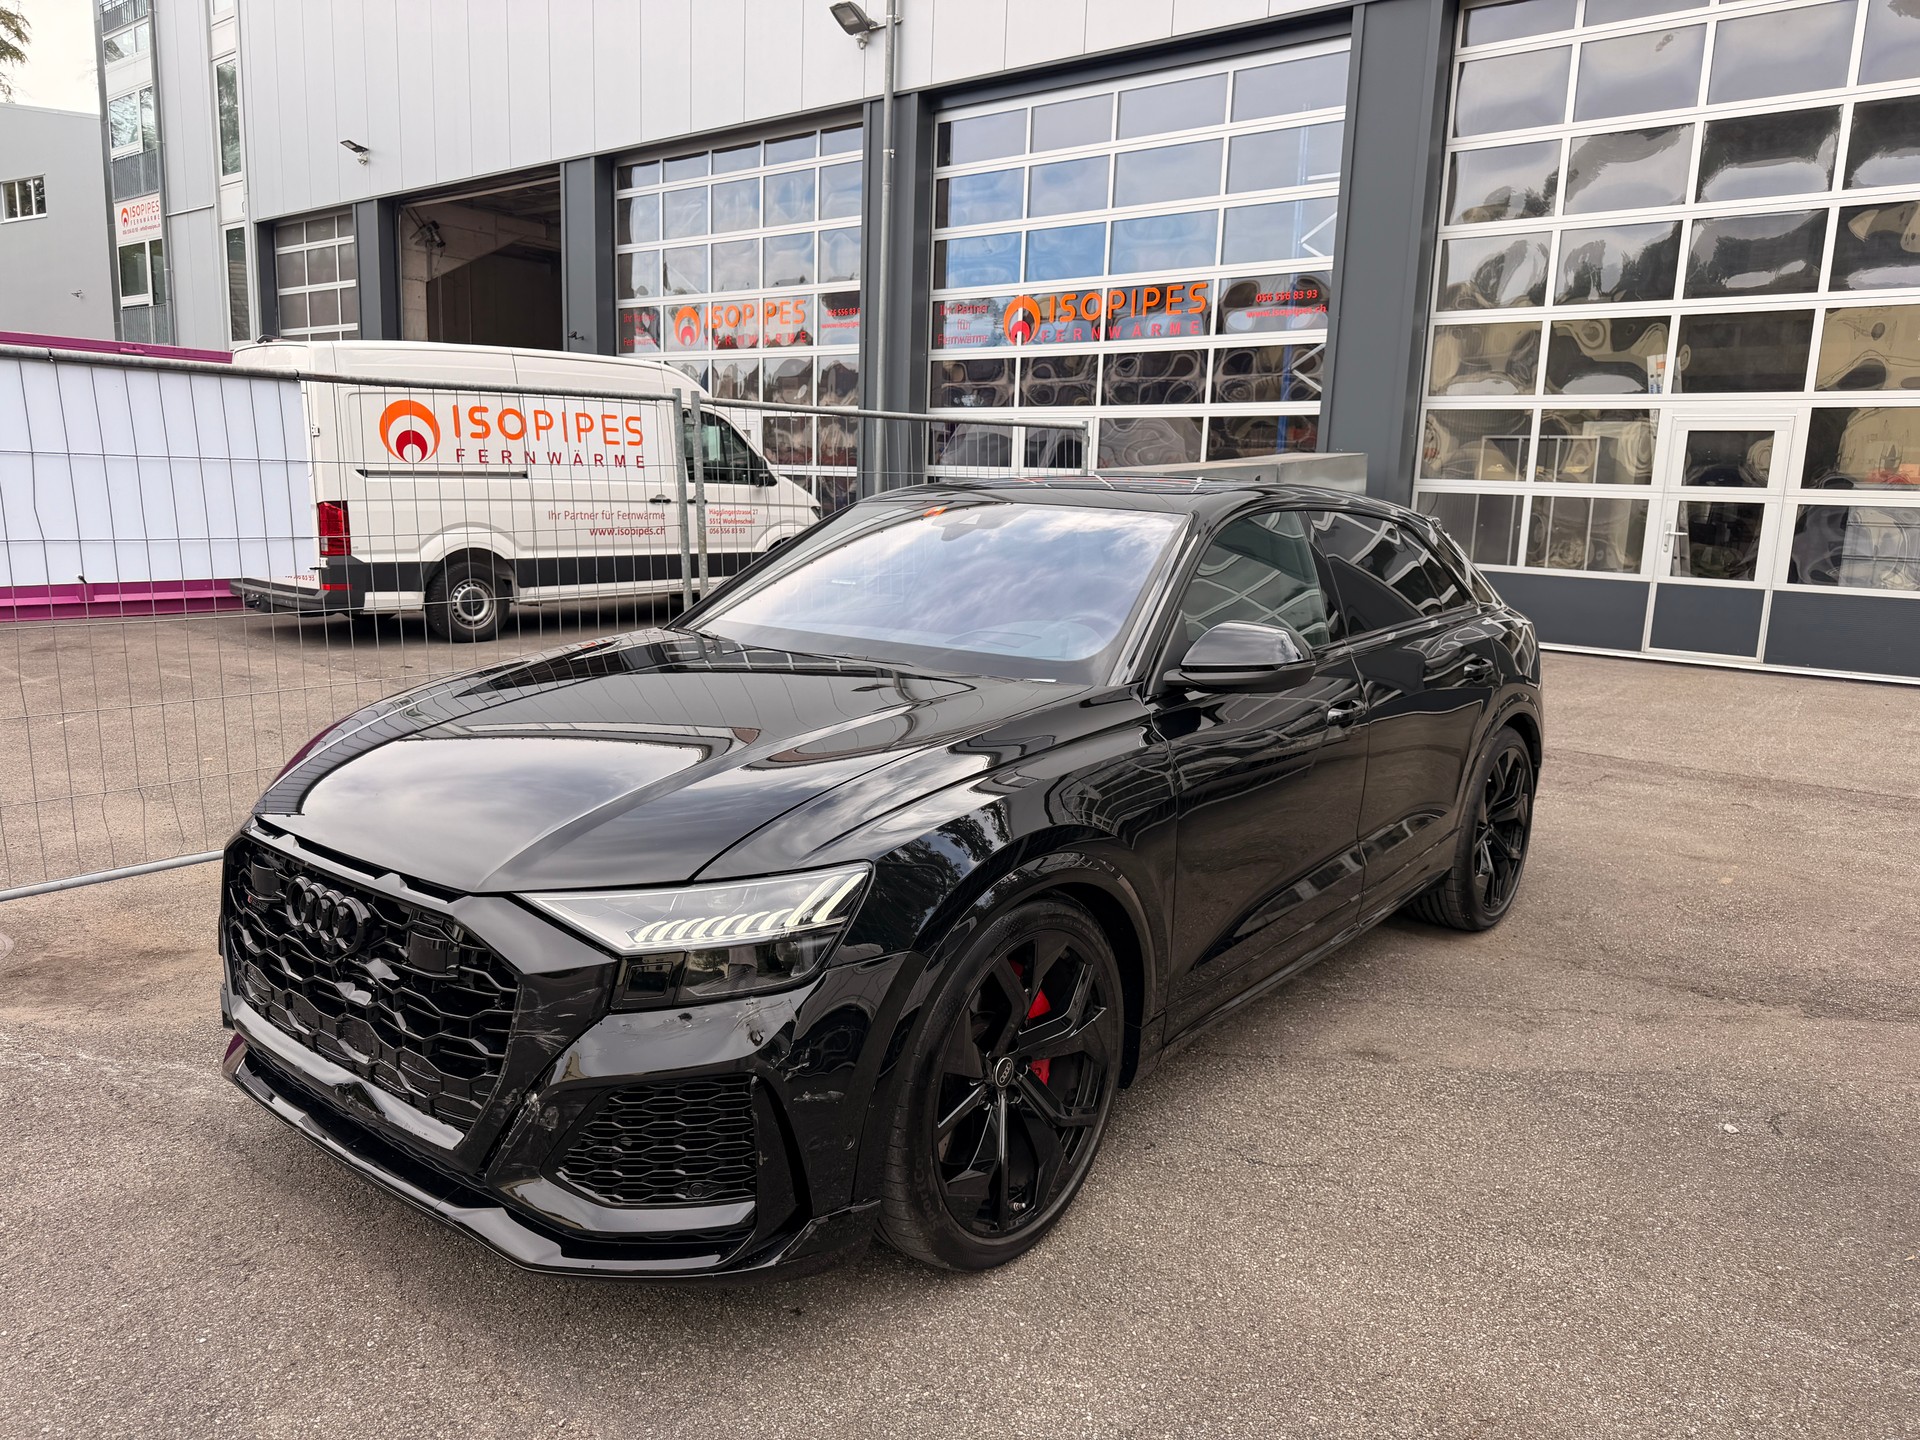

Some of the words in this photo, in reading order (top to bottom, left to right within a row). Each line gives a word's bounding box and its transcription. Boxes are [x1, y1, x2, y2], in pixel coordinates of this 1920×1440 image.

[130, 200, 160, 218] ISOPIPES
[1049, 281, 1208, 323] ISOPIPES
[1255, 292, 1273, 303] 056
[1275, 291, 1291, 302] 556
[1293, 290, 1305, 300] 83
[1306, 288, 1319, 299] 93
[704, 299, 806, 329] ISOPIPES
[1246, 304, 1327, 318] www.isopipes.ch
[1041, 320, 1200, 343] FERNWÄRME
[452, 404, 644, 447] ISOPIPES
[456, 448, 646, 470] FERNWÄRME
[548, 510, 561, 520] Ihr
[564, 510, 599, 520] Partner
[601, 509, 614, 520] für
[617, 510, 666, 520] Fernwärme
[589, 525, 666, 537] www.isopipes.ch
